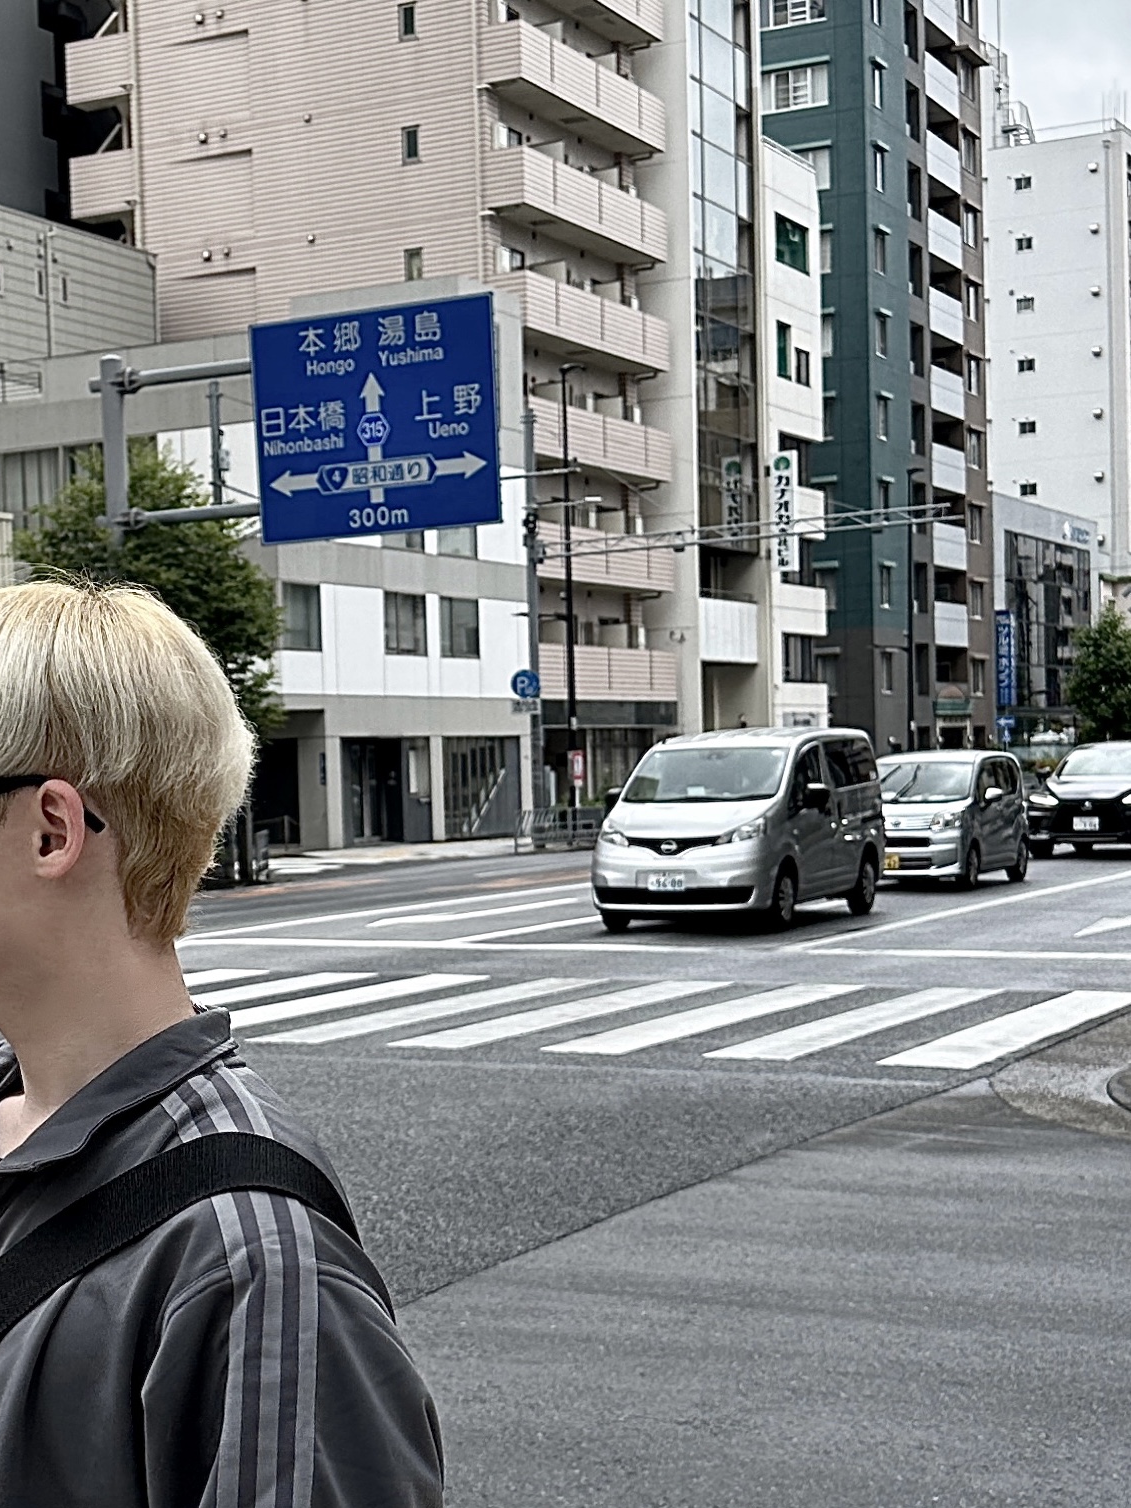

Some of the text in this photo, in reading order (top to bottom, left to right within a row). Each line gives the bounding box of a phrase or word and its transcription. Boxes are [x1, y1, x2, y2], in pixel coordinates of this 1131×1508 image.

[298, 310, 442, 357] 本郷 湯島
[306, 346, 444, 377] Hongo Yushima
[414, 383, 482, 421] 上野
[261, 400, 346, 437] 日本橋
[362, 421, 384, 438] 315
[428, 421, 469, 439] Ueno
[263, 432, 345, 457] Nihonbashi
[331, 470, 341, 483] 4
[352, 461, 422, 486] 昭和通り
[348, 506, 409, 529] 300m
